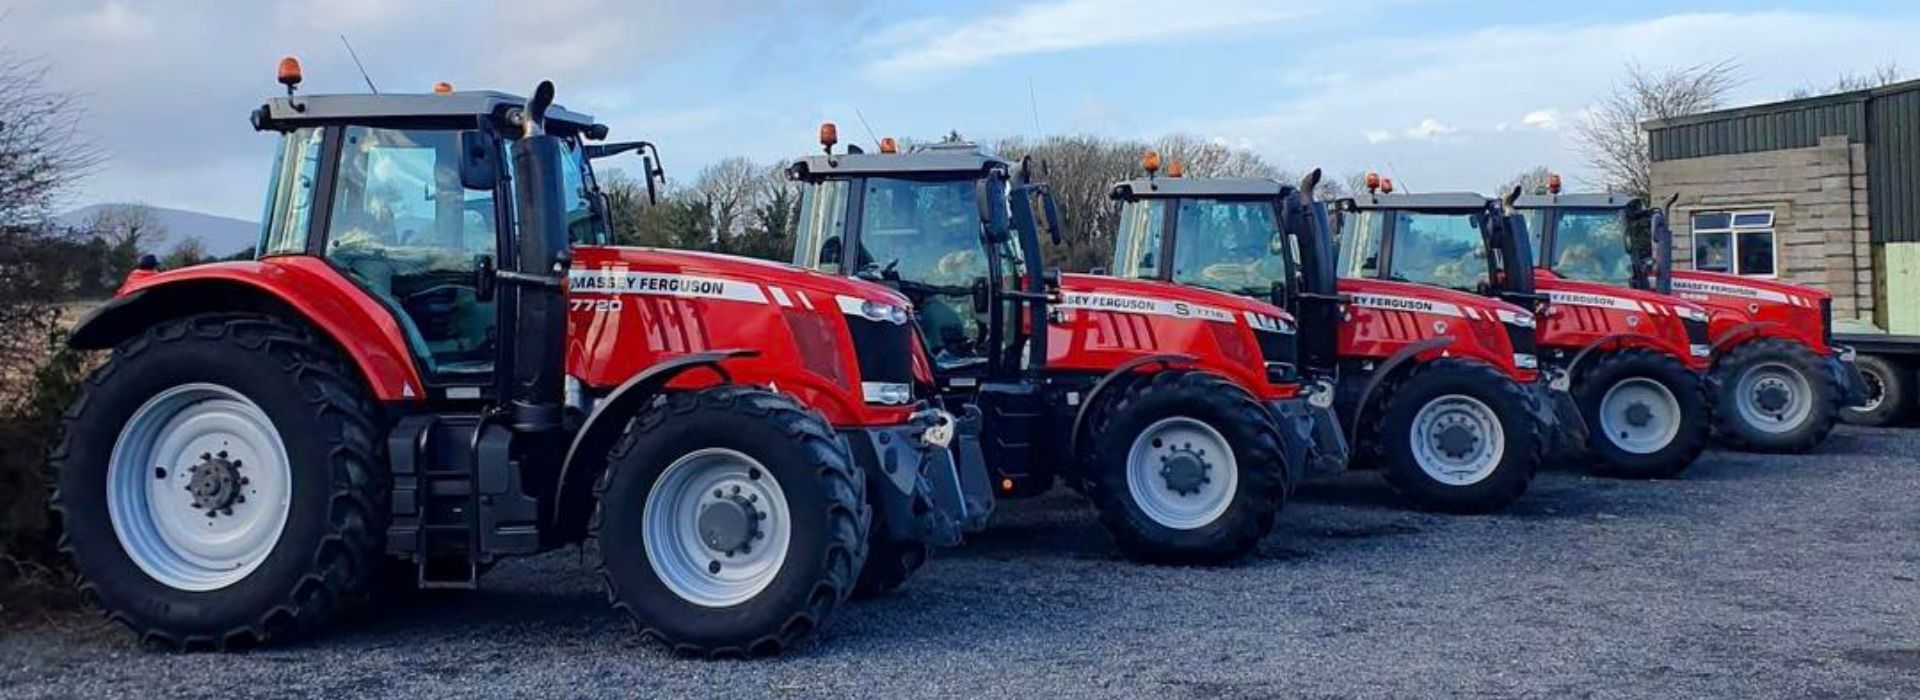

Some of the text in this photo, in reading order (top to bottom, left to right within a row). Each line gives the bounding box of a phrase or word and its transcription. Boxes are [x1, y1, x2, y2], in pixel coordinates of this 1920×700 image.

[570, 276, 725, 294] MASSEY FERGUSON
[570, 299, 623, 311] 7720
[1092, 296, 1155, 310] FERGUSON
[1370, 297, 1432, 310] FERGUSON
[1560, 294, 1615, 306] FERGUSON
